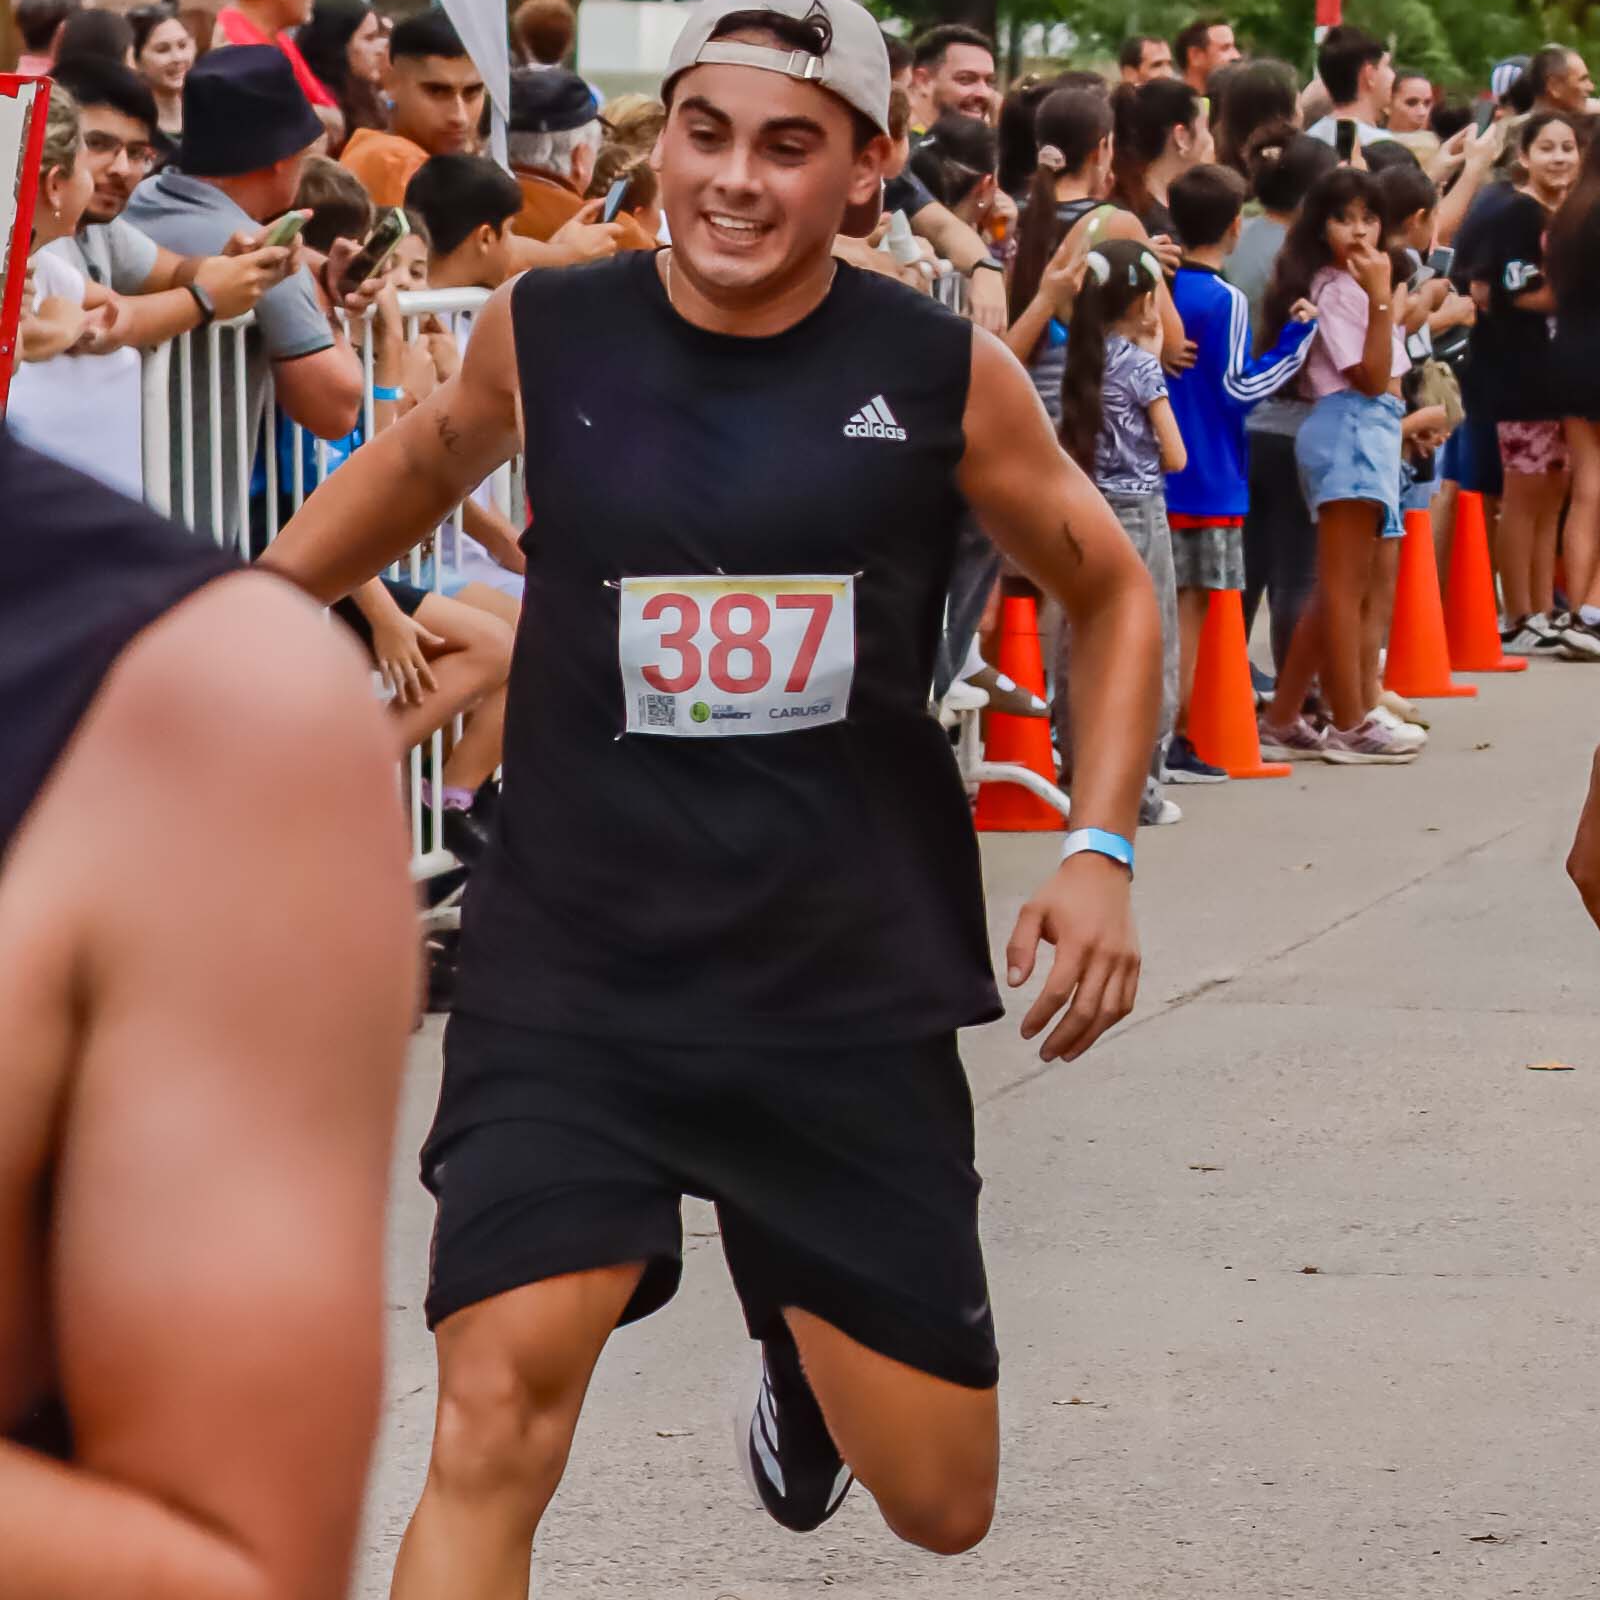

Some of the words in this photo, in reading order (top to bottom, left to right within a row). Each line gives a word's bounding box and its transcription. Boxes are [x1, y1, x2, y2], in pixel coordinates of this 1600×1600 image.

[844, 420, 907, 441] adidas
[640, 593, 833, 694] 387
[769, 703, 832, 719] CARUSO
